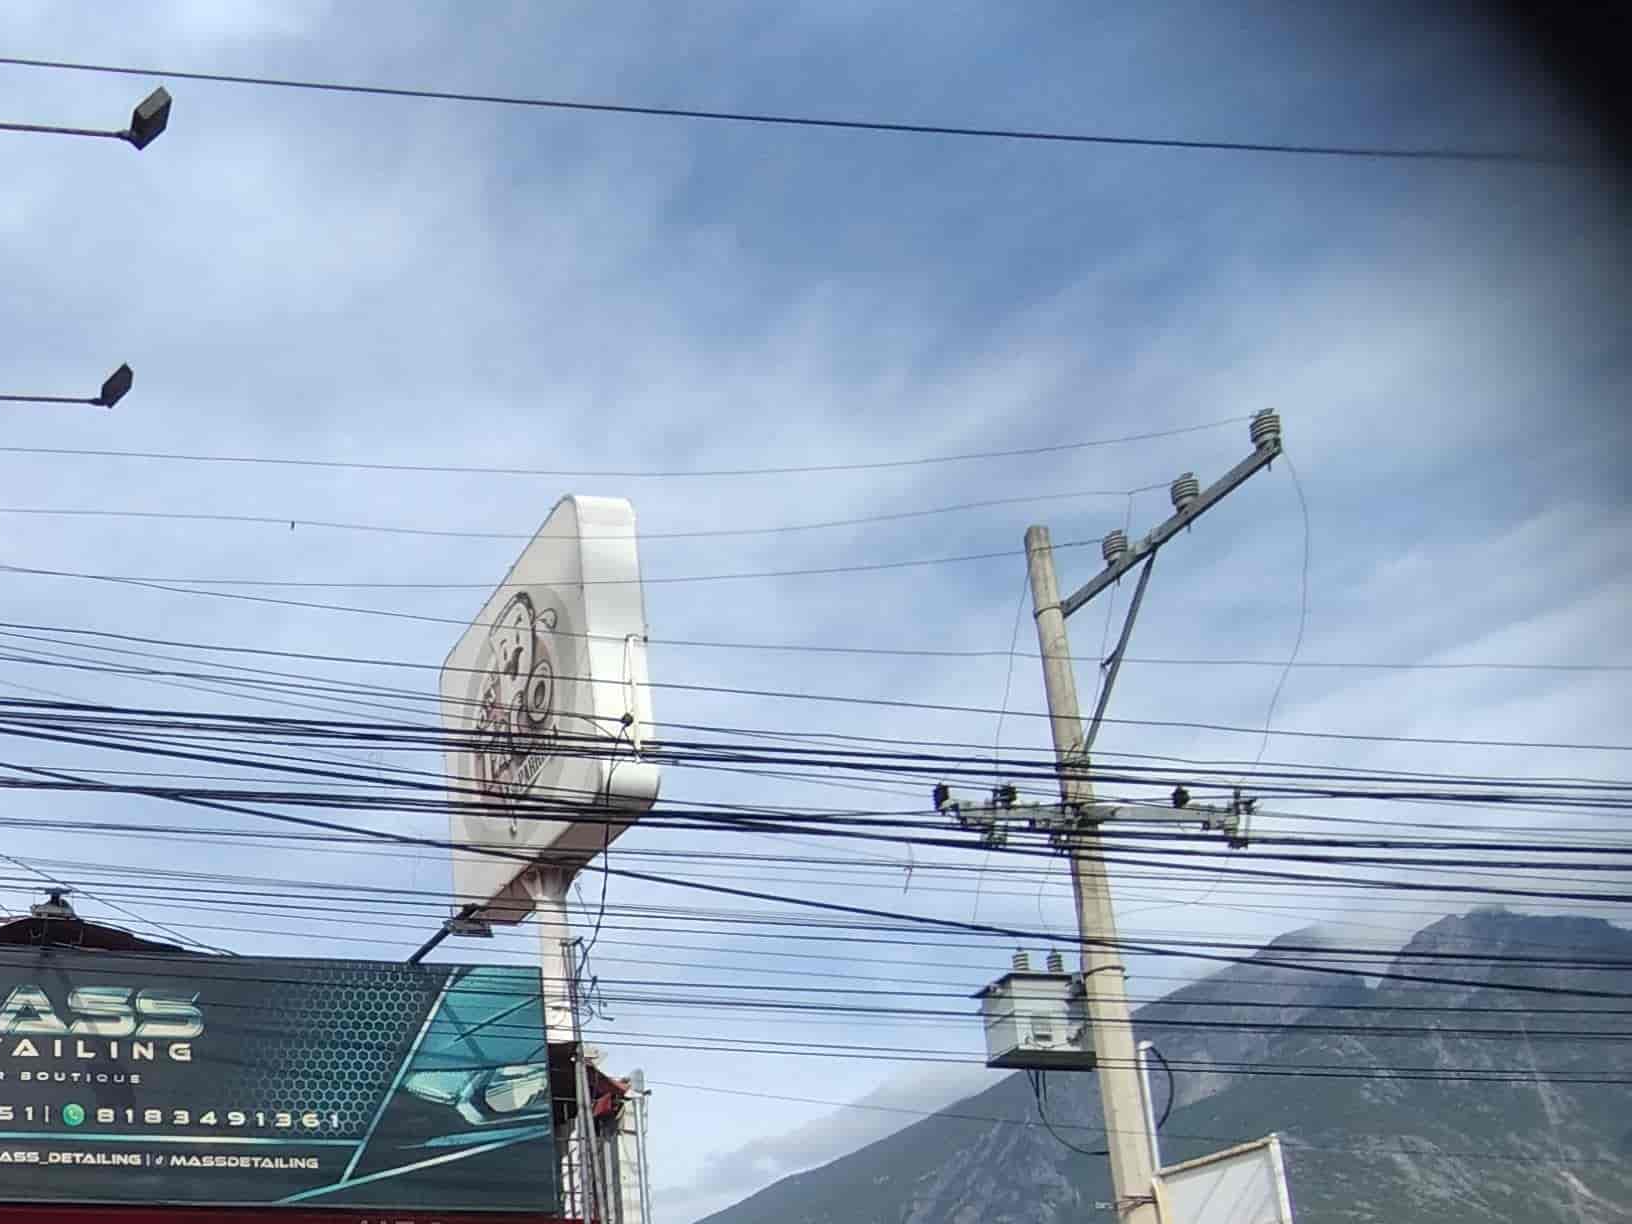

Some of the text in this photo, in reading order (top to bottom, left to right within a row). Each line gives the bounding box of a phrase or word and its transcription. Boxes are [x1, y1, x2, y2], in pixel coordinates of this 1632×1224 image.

[20, 1071, 142, 1084] BOUTIQUE
[97, 1108, 339, 1129] 8183491361
[170, 1155, 319, 1169] MASSDETAILING
